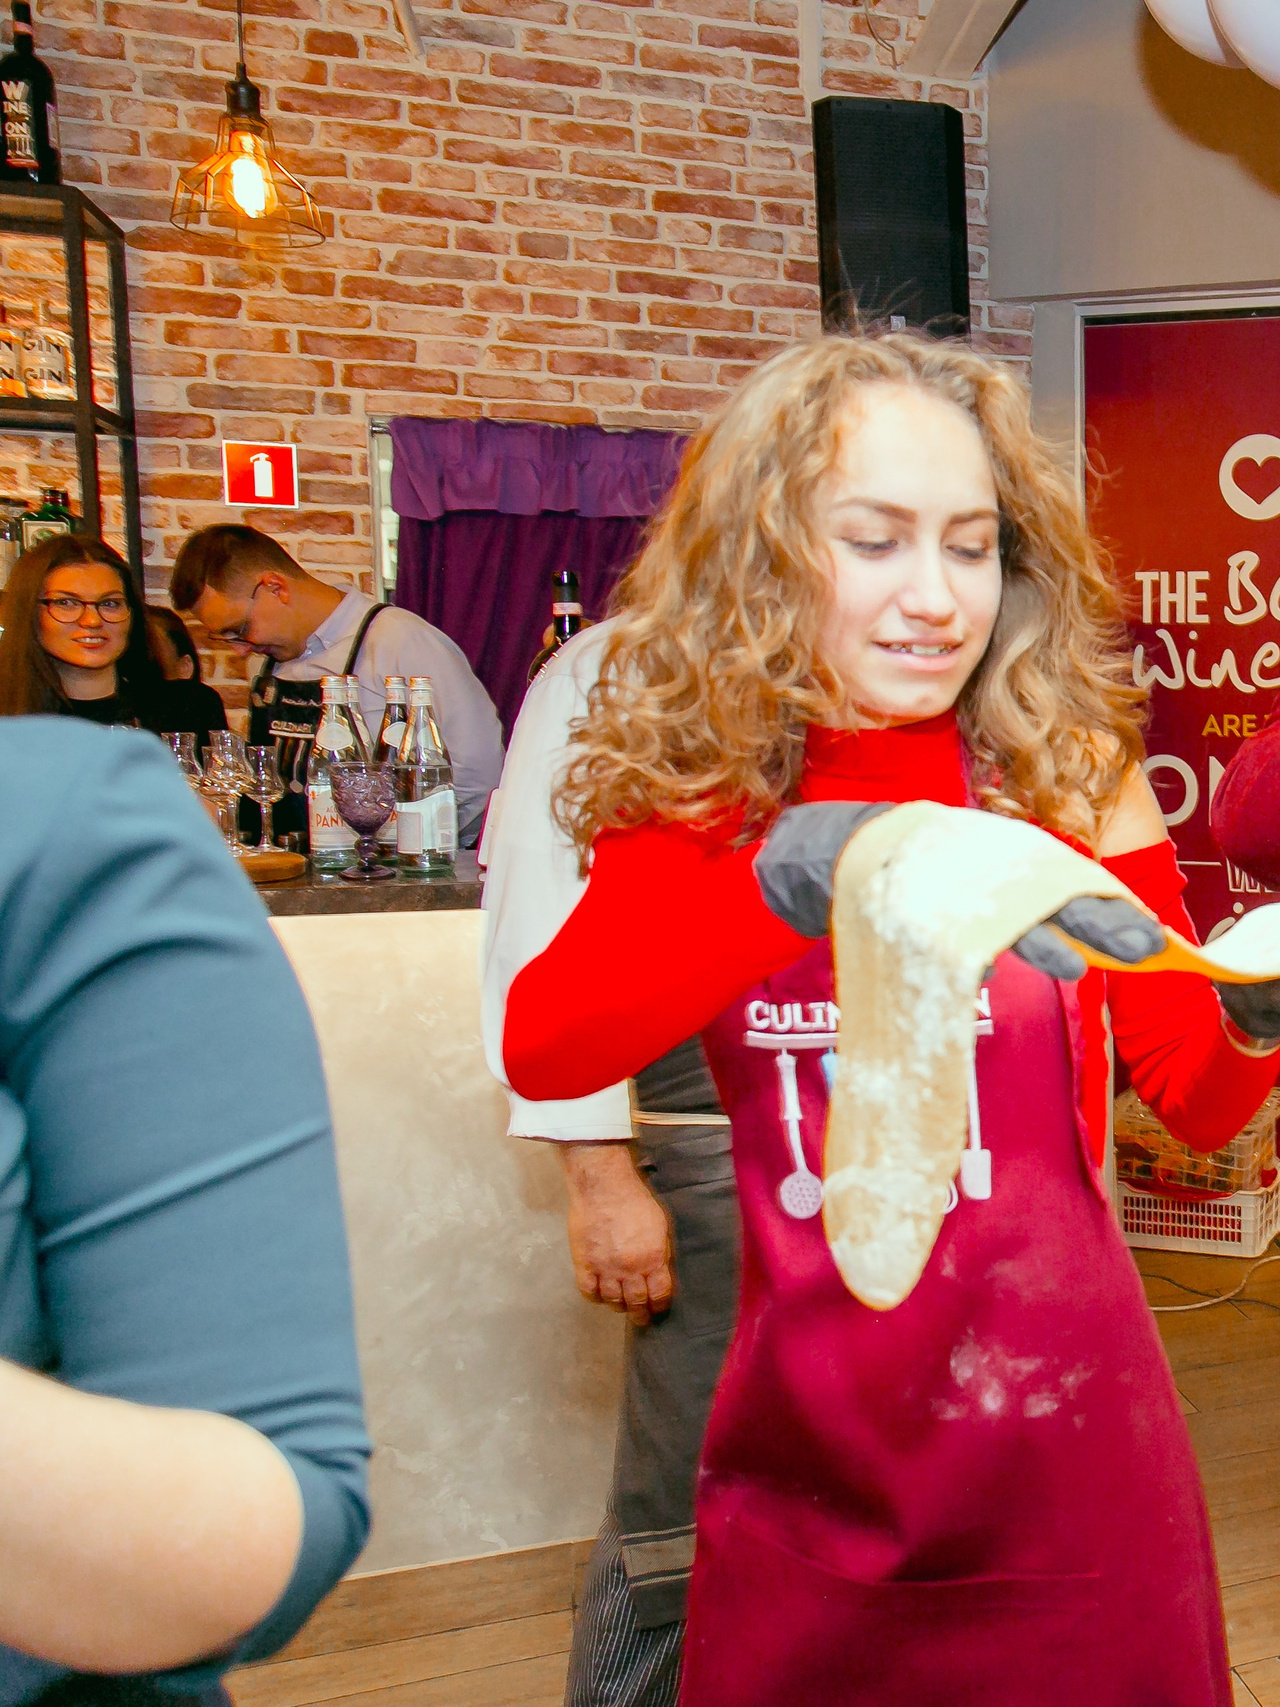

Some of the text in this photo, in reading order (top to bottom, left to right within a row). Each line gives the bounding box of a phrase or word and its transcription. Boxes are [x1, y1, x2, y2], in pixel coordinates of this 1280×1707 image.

[1134, 570, 1210, 624] THE
[1201, 713, 1257, 738] ARE
[747, 1000, 841, 1032] CULIN
